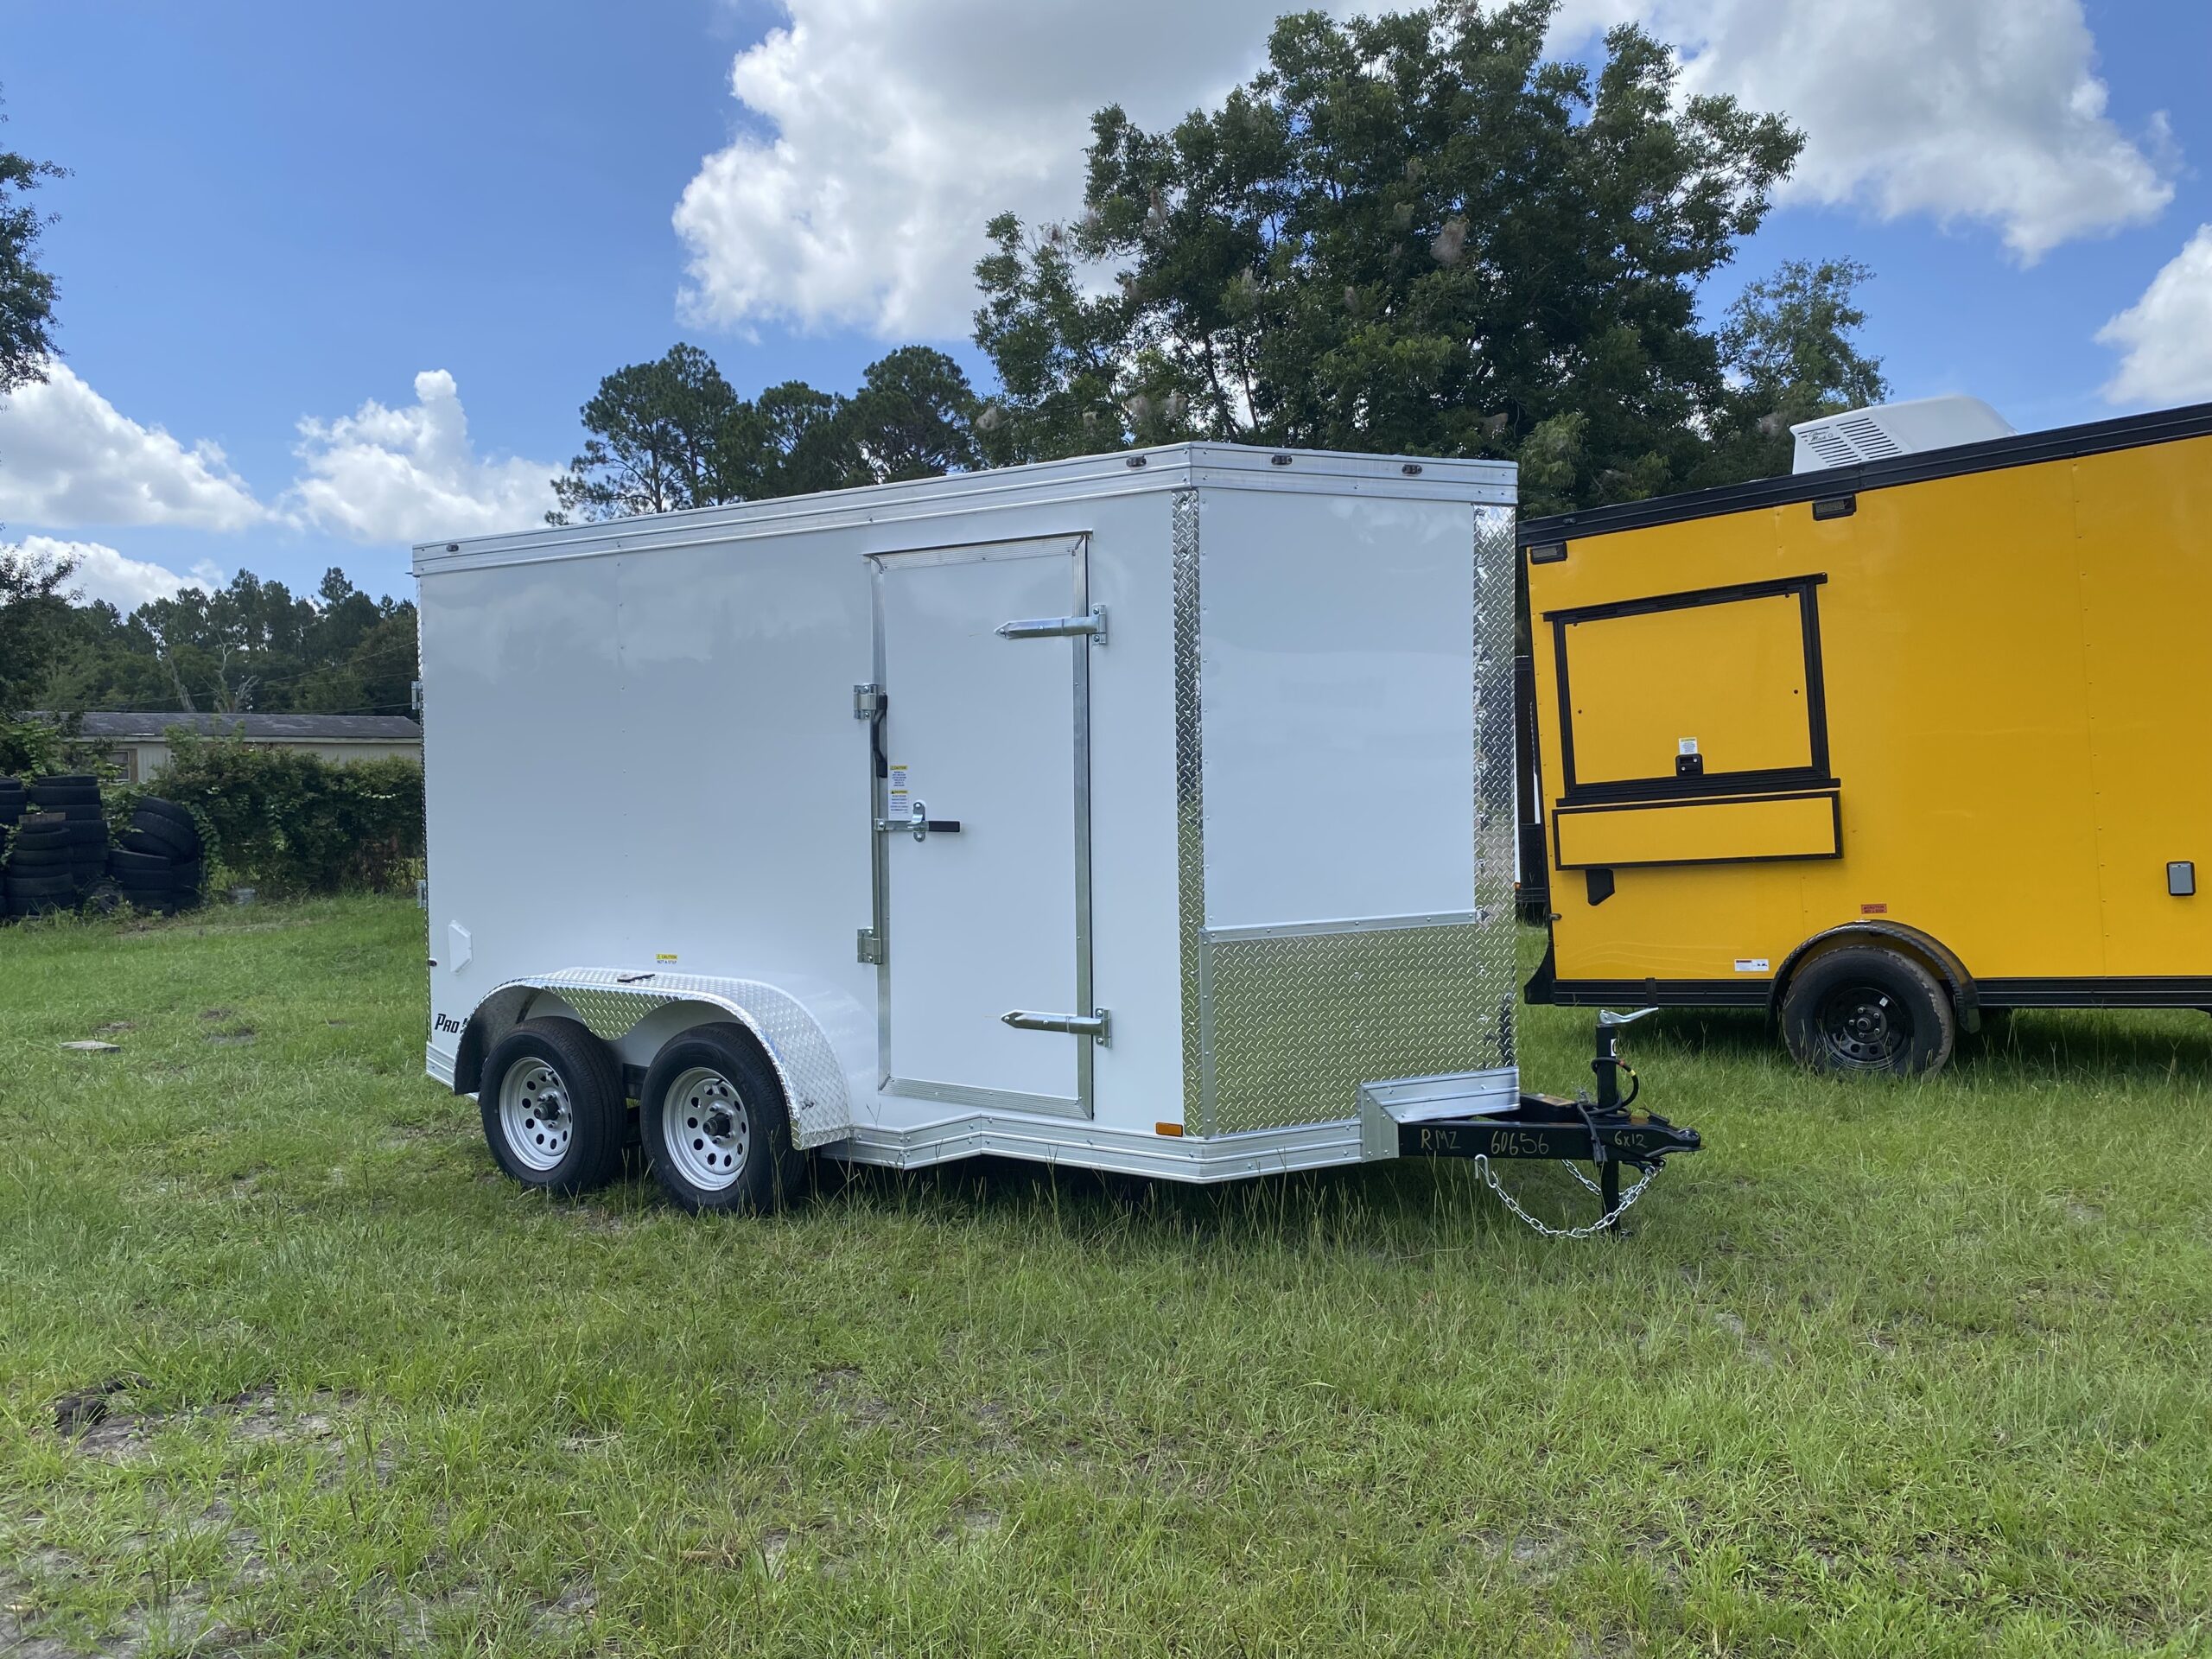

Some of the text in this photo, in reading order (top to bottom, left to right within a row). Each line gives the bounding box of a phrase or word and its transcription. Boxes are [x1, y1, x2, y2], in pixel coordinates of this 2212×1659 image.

[1421, 1128, 1648, 1156] RMZ 60656 6x12
